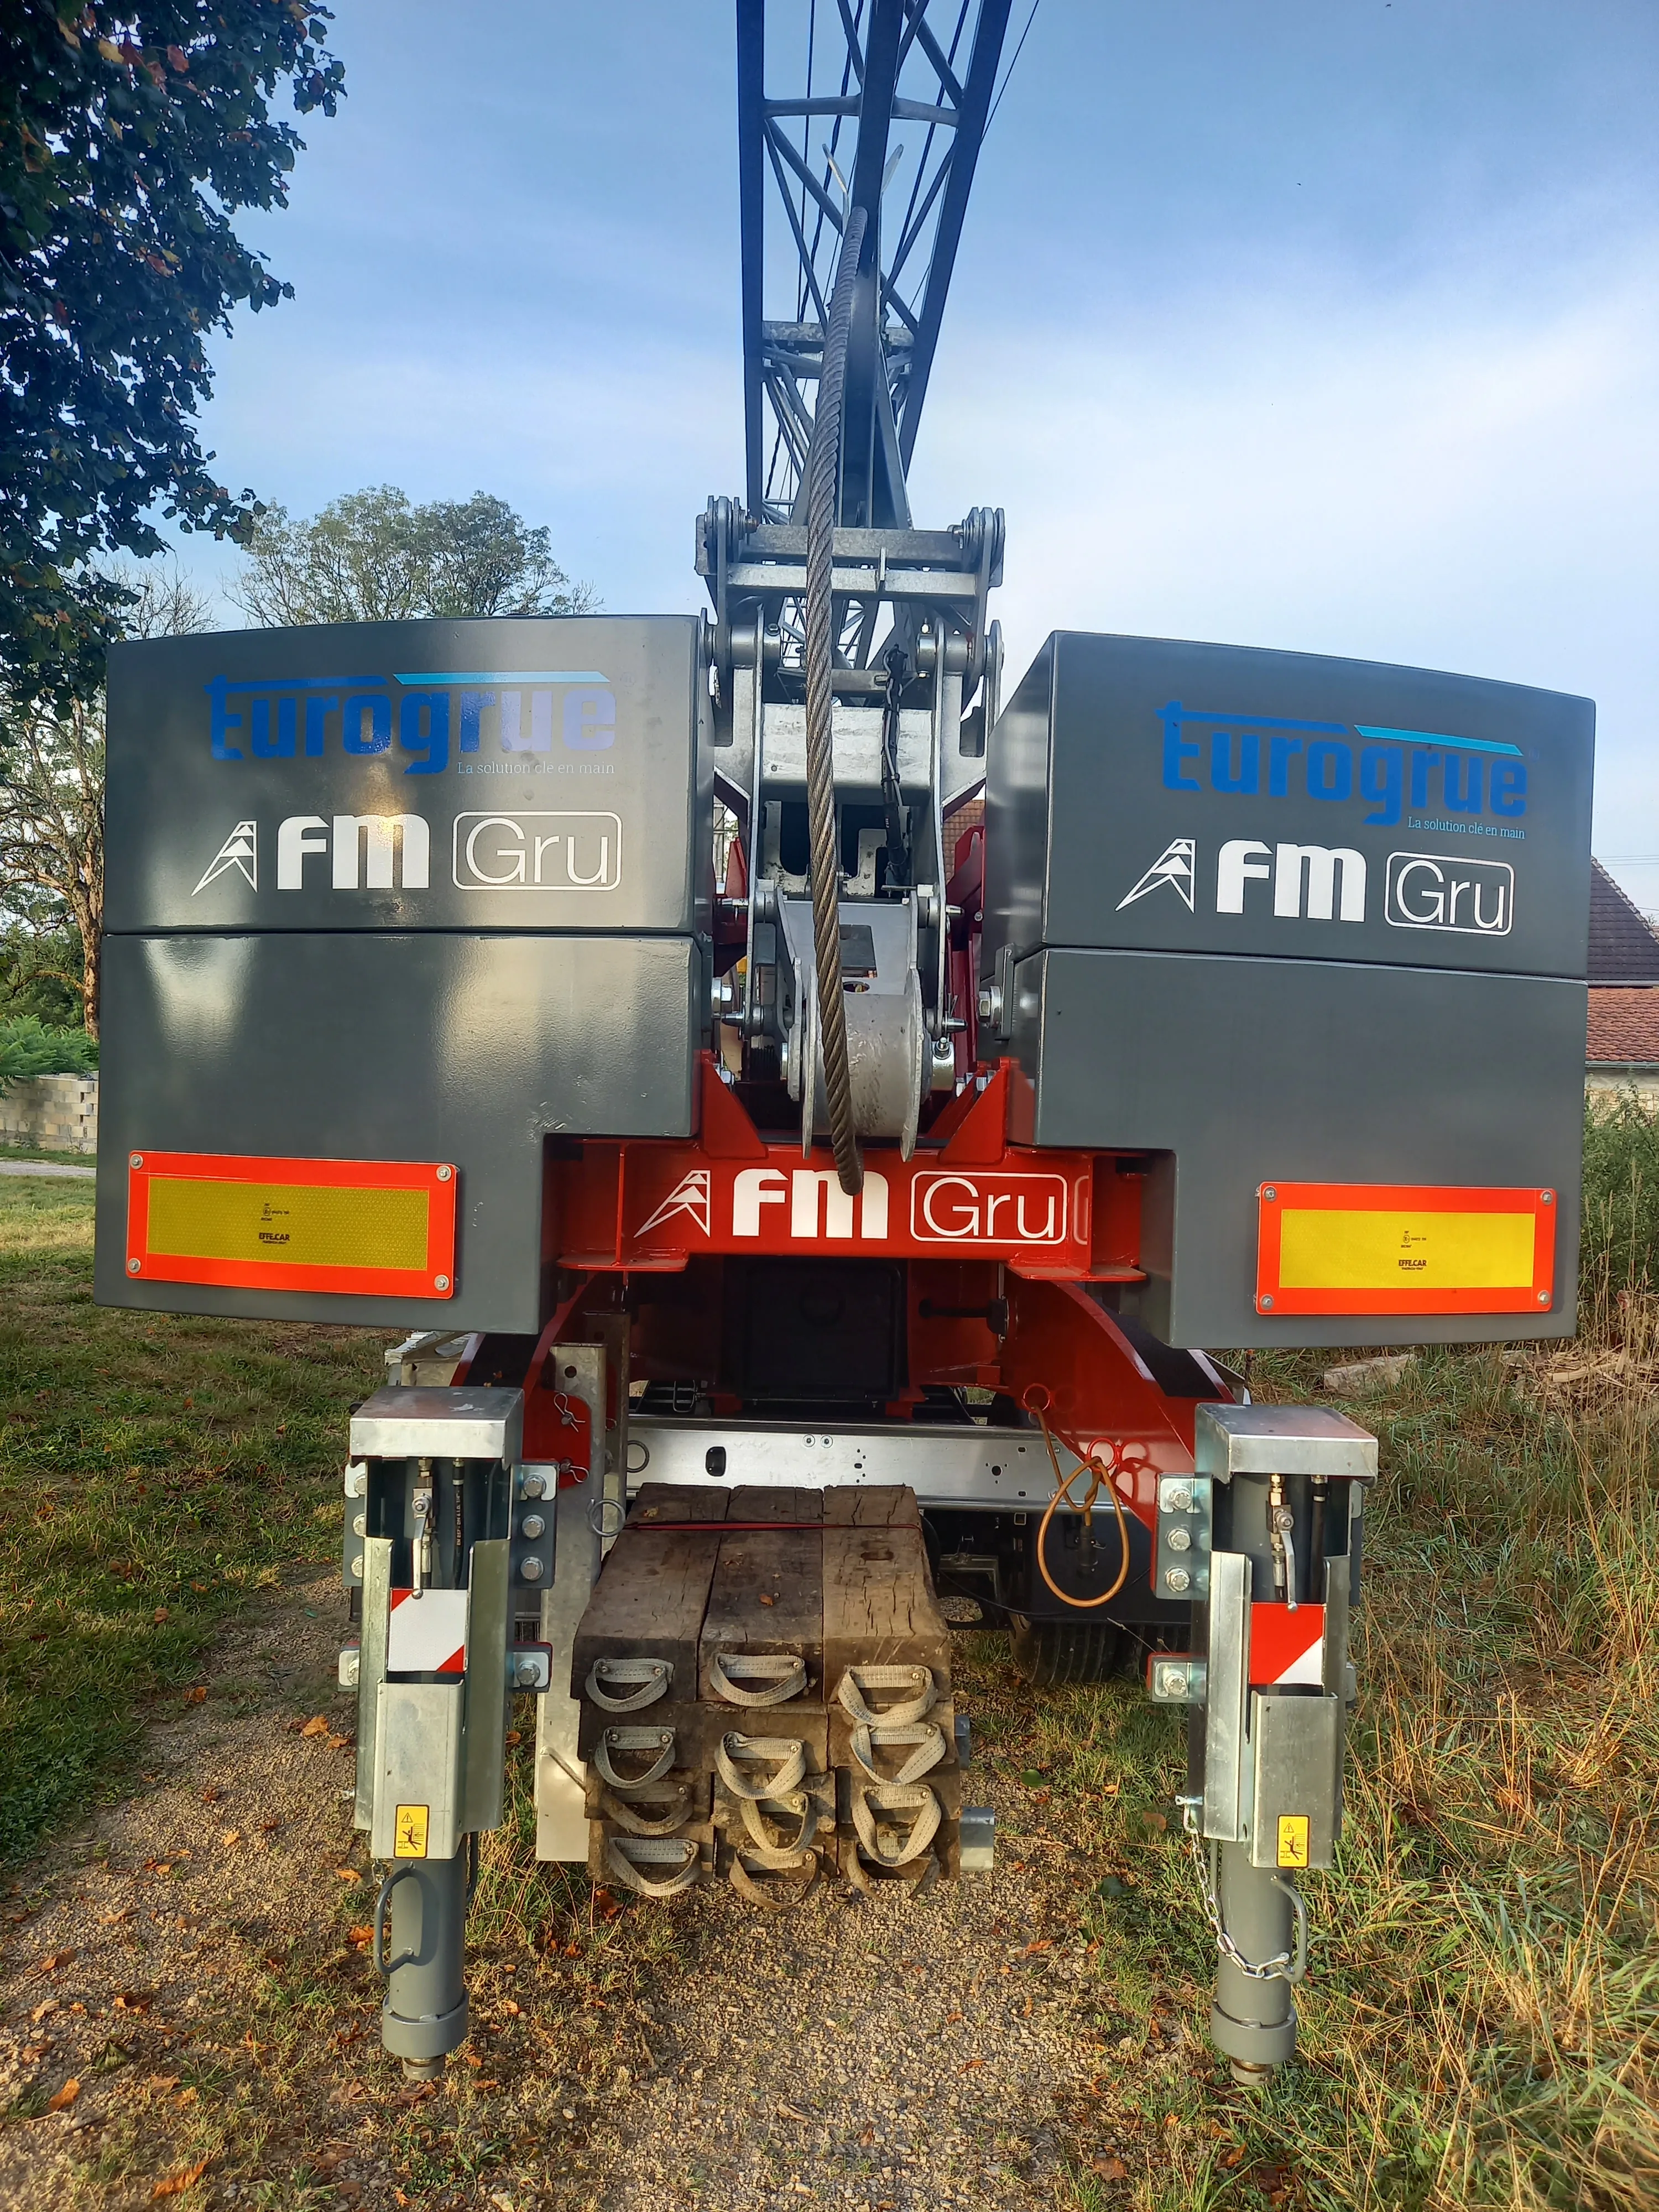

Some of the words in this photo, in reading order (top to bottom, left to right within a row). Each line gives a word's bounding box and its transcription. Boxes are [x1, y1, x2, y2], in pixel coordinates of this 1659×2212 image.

[203, 674, 617, 774] Eurogrue
[457, 761, 473, 774] La
[477, 761, 530, 774] solution
[558, 764, 573, 774] en
[579, 761, 615, 774] main
[1155, 700, 1528, 826] Eurogrue
[466, 817, 609, 884] Gru
[1408, 816, 1421, 828] La
[1424, 818, 1466, 833] solution
[1468, 822, 1483, 834] clé
[1485, 827, 1498, 837] en
[1500, 827, 1526, 839] main
[1396, 859, 1504, 930] Gru
[923, 1177, 1055, 1239] Gru
